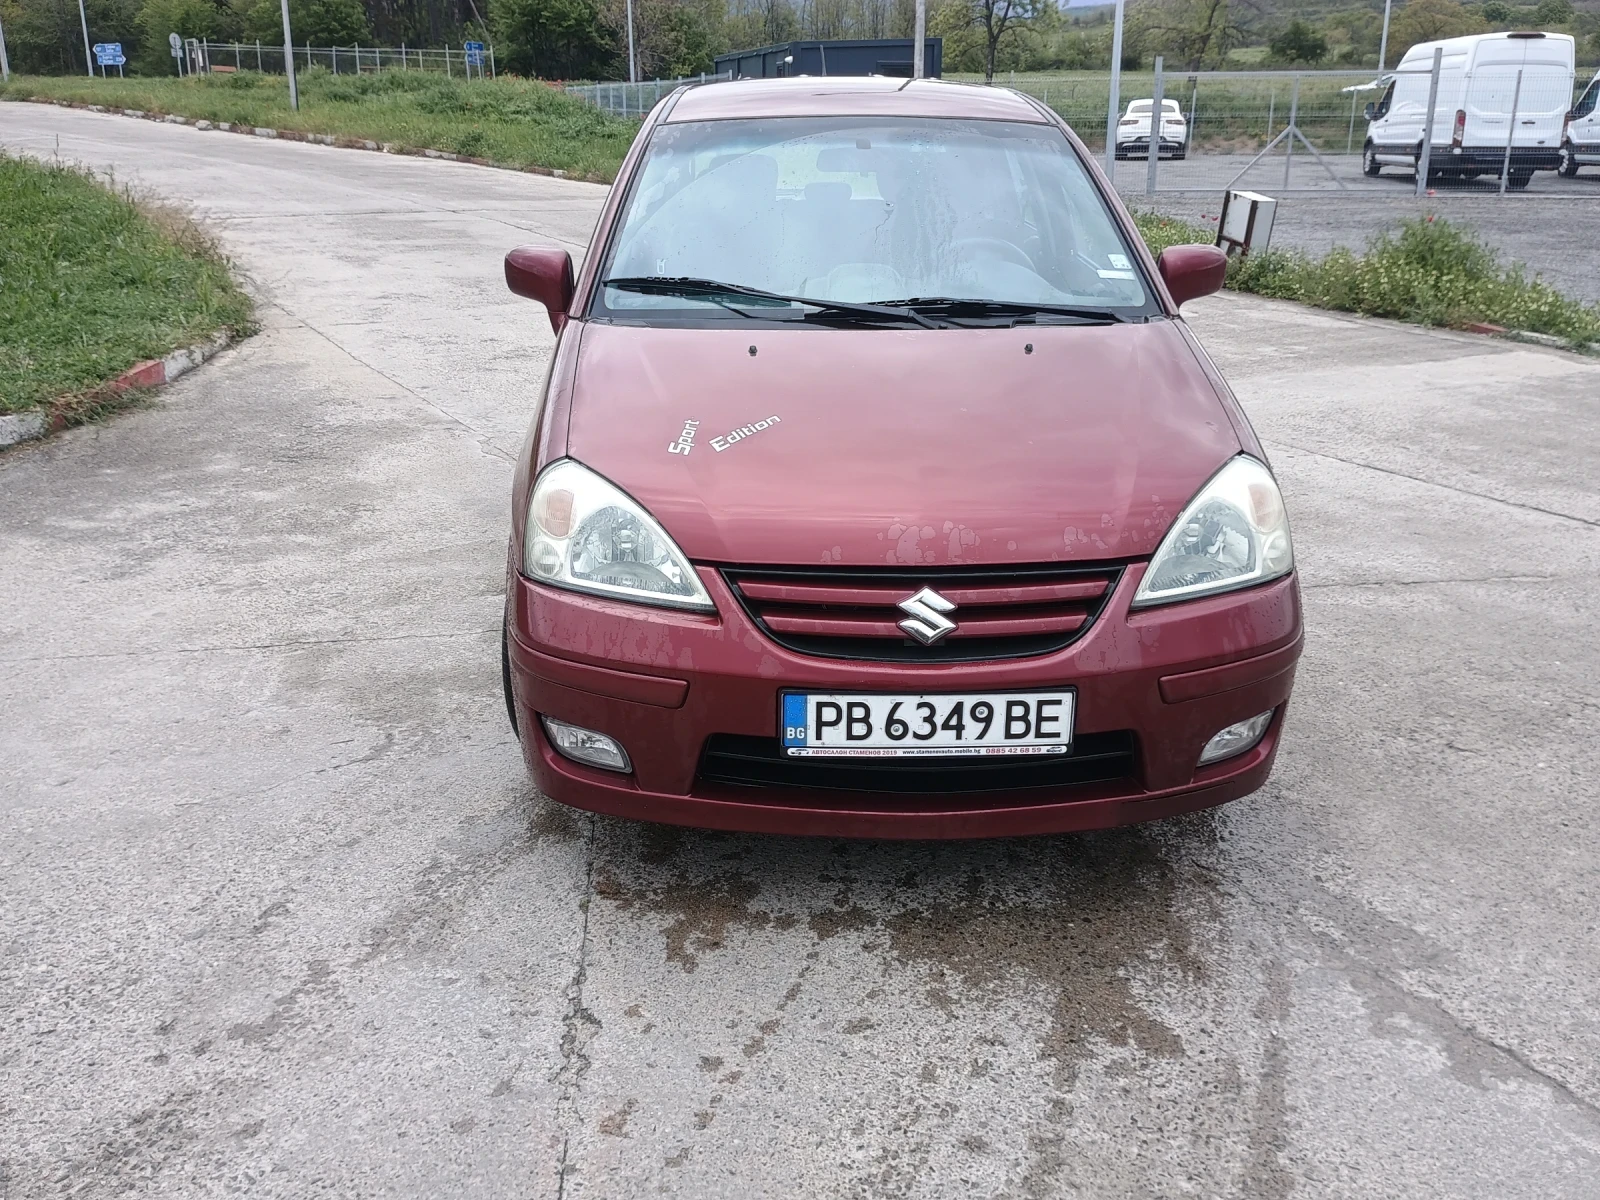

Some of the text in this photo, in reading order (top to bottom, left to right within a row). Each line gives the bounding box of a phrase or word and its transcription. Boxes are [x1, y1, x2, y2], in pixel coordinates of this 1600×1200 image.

[667, 419, 700, 456] Sport
[709, 415, 782, 453] Edition
[786, 727, 805, 739] BG
[815, 699, 1062, 741] PB 6349 BE
